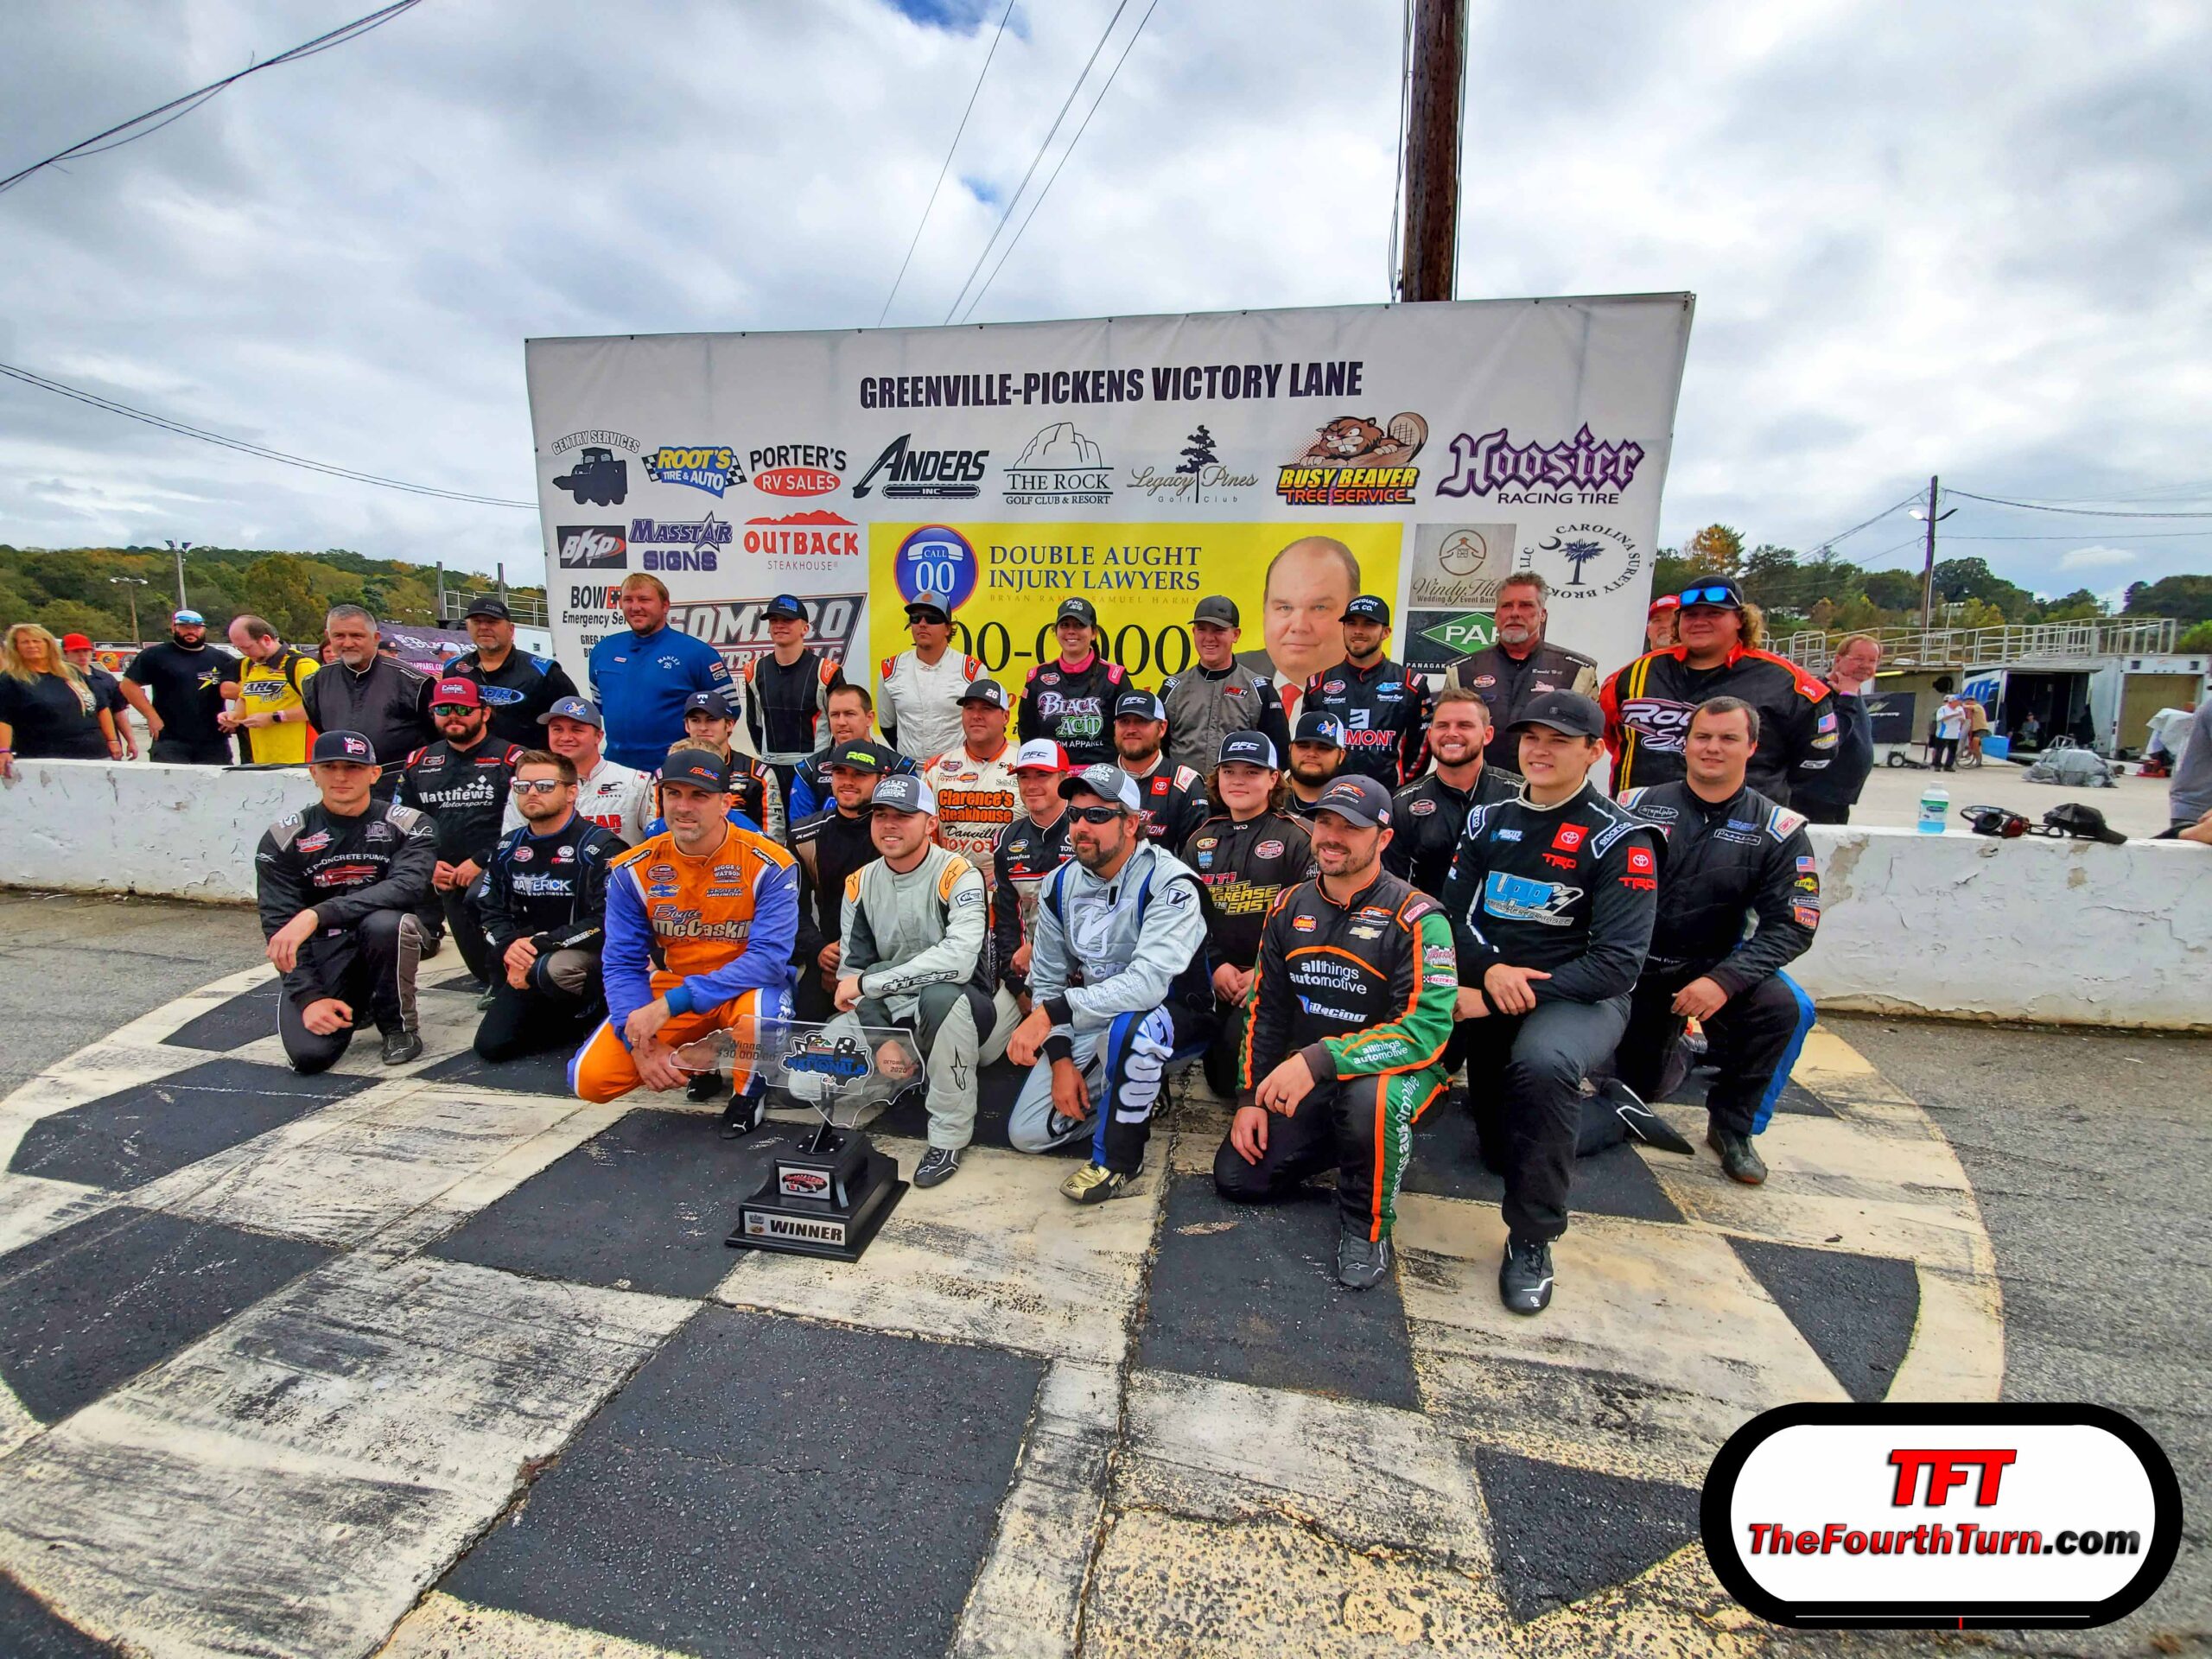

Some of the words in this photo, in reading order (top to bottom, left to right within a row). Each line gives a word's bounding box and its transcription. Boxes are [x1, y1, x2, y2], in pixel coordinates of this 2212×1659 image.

[860, 367, 1144, 410] GREENVILLE-PICKENS
[1151, 363, 1283, 402] VICTORY
[1288, 360, 1363, 398] LANE
[551, 431, 589, 455] GENTRY
[589, 430, 641, 454] SERVICES
[657, 449, 733, 470] ROOT'S
[749, 443, 848, 472] PORTER'S
[1435, 422, 1645, 498] Hoosier
[662, 470, 681, 480] TIRE
[690, 471, 725, 491] AUTO
[762, 474, 782, 490] RV
[785, 474, 836, 490] SALES
[1007, 473, 1047, 491] THE
[1053, 473, 1110, 490] ROCK
[1126, 467, 1197, 496] Legacy
[1201, 466, 1259, 488] Pines
[1278, 467, 1335, 488] BUSY
[1338, 467, 1418, 488] BEAVER
[1006, 496, 1033, 505] GOLF
[1034, 496, 1061, 505] CLUB
[1062, 496, 1070, 505] &
[1071, 495, 1111, 505] RESORT
[1284, 489, 1327, 504] TREE
[1333, 488, 1414, 504] SERVICE
[1497, 493, 1573, 505] RACING
[1580, 493, 1619, 505] TIRE
[743, 531, 859, 556] OUTBACK
[1555, 523, 1636, 551] CAROLINA
[643, 550, 718, 571] SIGNS
[924, 549, 948, 558] CALL
[988, 545, 1096, 566] DOUBLE
[1102, 546, 1202, 566] AUGHT
[1519, 547, 1535, 569] LLC
[988, 569, 1077, 592] INJURY
[1082, 570, 1201, 591] LAWYERS
[1603, 552, 1641, 594] SURETY
[1417, 595, 1446, 604] Wedding
[563, 610, 610, 628] Emergency
[985, 688, 1000, 699] 26
[938, 788, 1015, 808] Clarence's
[938, 806, 1014, 823] Steakhouse
[1599, 821, 1634, 846] sparco
[1541, 852, 1577, 869] TRD
[1213, 887, 1281, 903] GREASE
[1618, 877, 1657, 892] TRD
[882, 969, 959, 991] alpinestars
[1289, 970, 1368, 995] automotive
[1308, 1002, 1368, 1023] iRacing
[770, 1219, 842, 1241] WINNER
